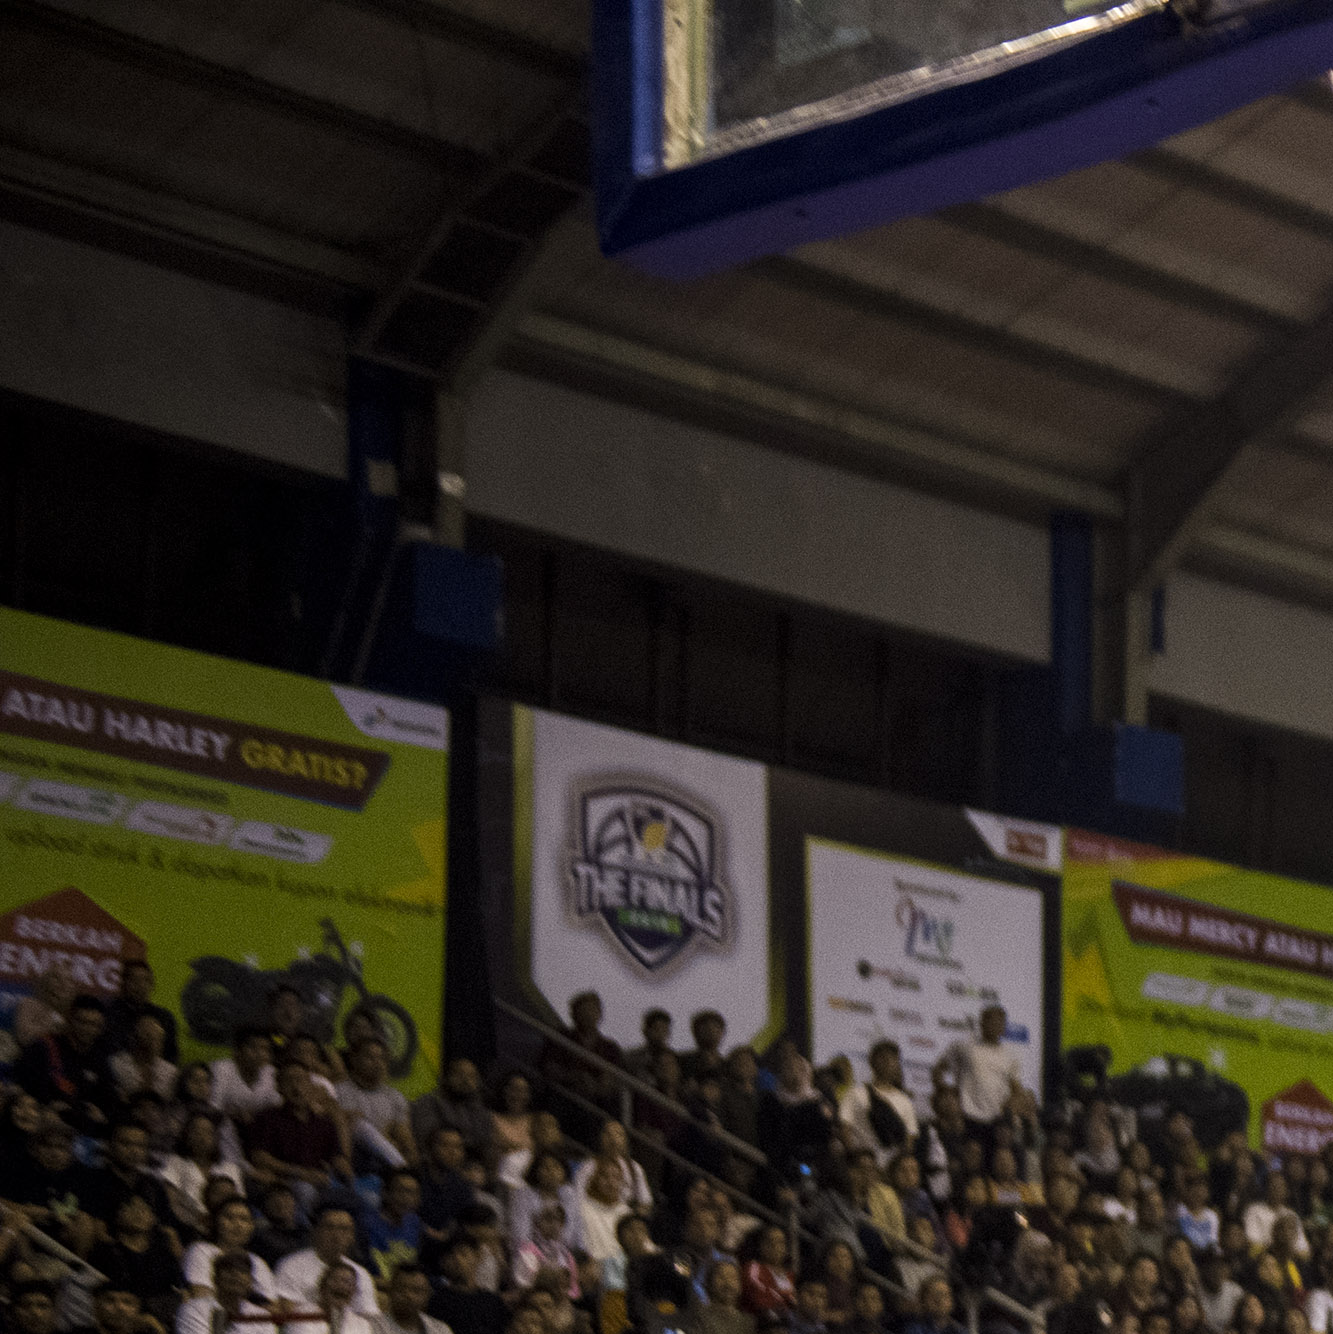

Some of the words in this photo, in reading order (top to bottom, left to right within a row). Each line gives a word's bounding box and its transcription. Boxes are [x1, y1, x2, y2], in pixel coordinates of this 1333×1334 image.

[2, 688, 94, 732] ATAU
[104, 707, 230, 761] HARLEY
[240, 738, 369, 791] GRATIS?
[1130, 901, 1184, 937] MAU
